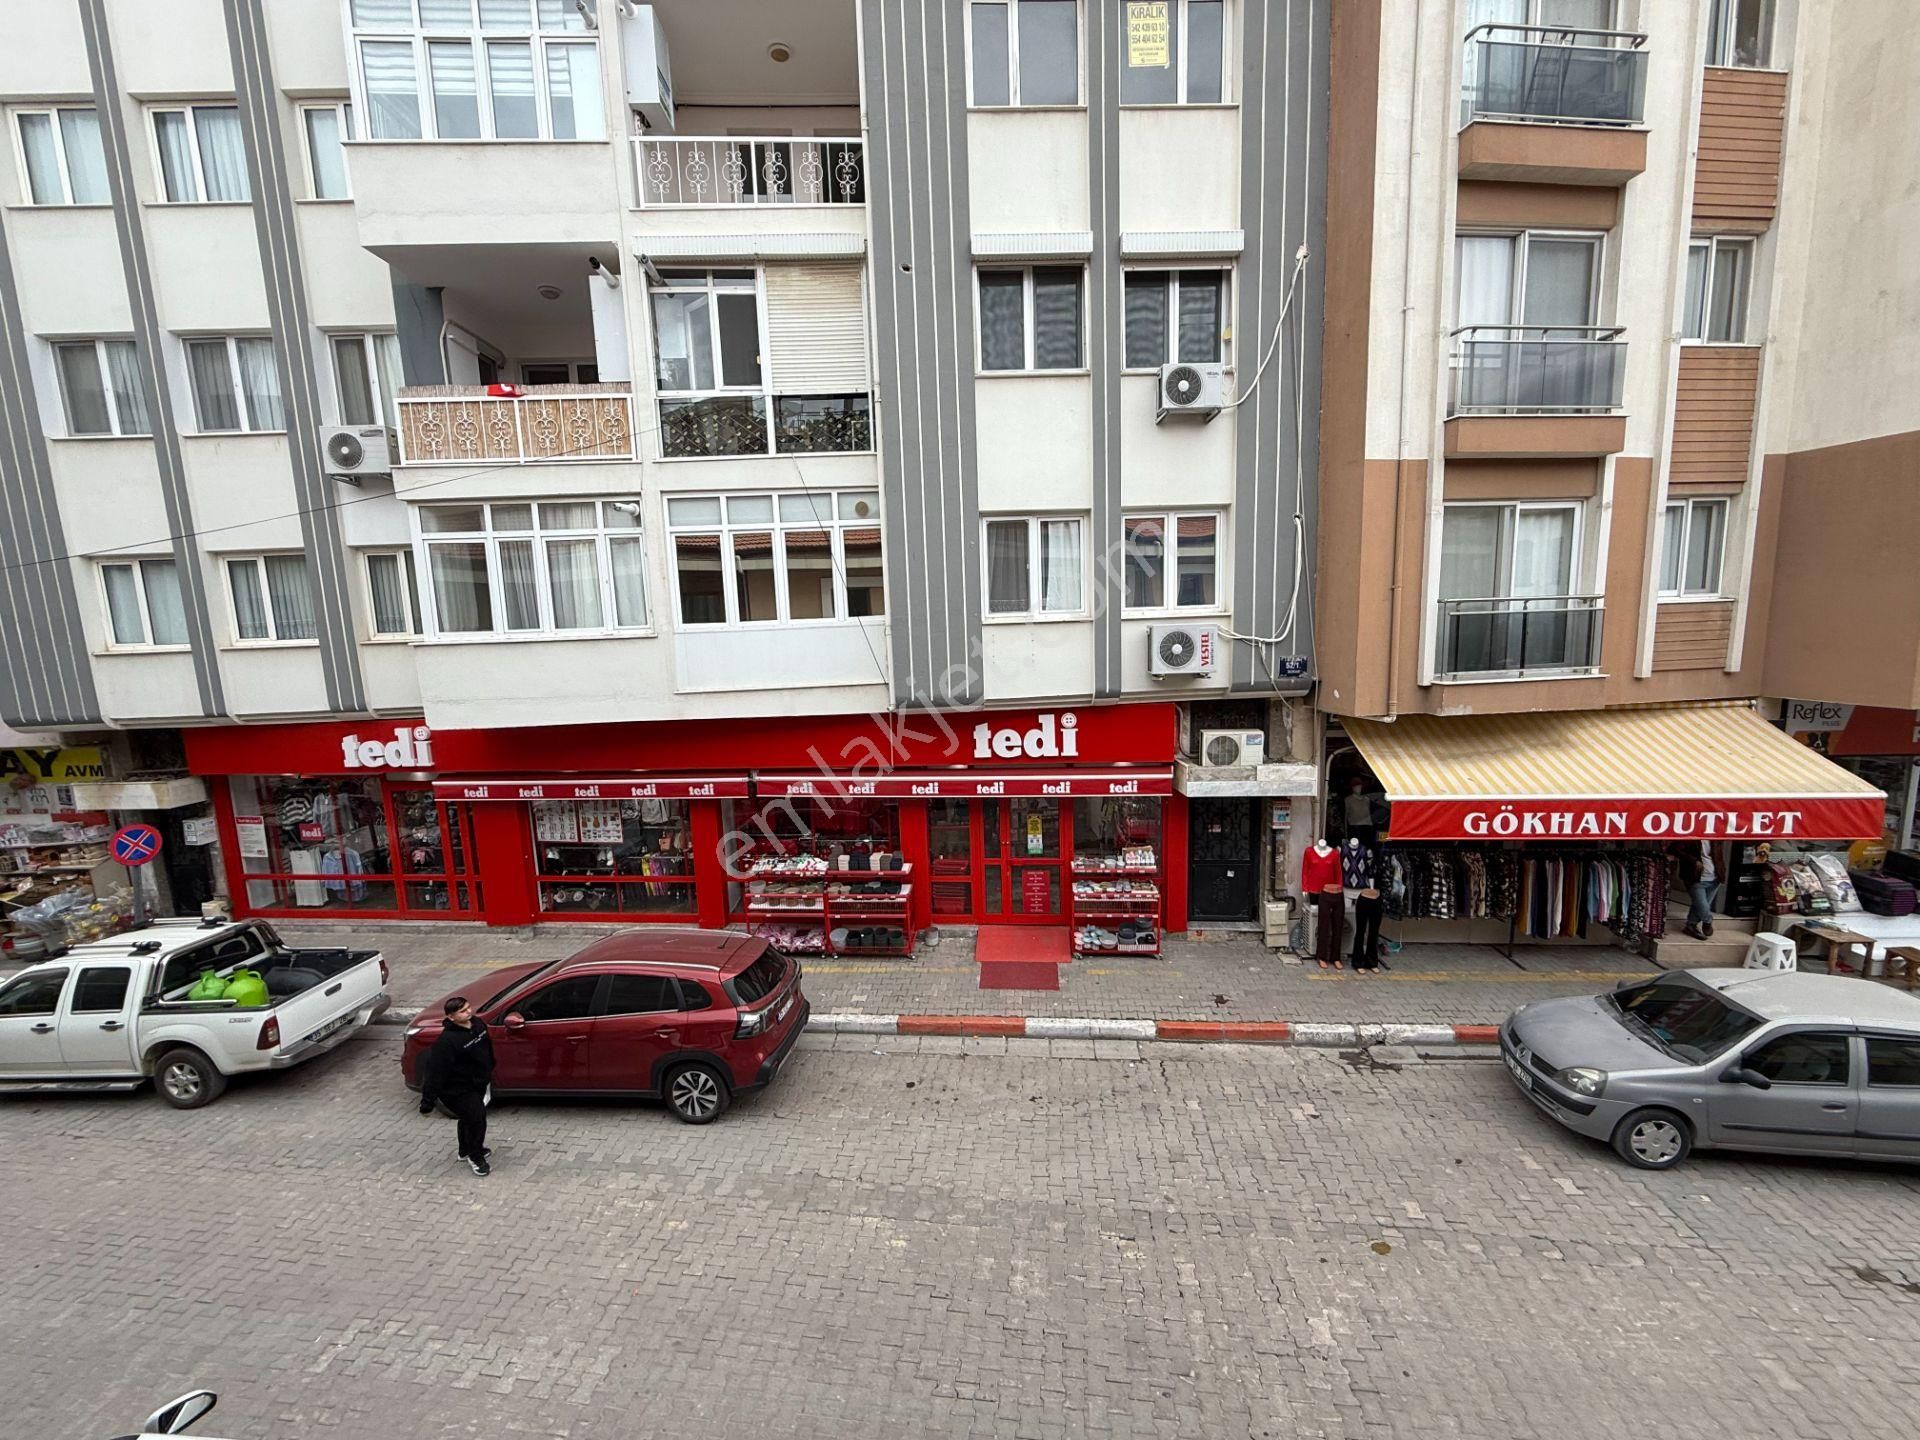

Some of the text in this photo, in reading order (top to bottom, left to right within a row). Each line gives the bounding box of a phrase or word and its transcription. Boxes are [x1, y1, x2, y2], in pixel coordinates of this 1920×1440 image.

[1201, 631, 1209, 667] VESTEL
[1792, 701, 1842, 723] Reflex
[973, 712, 1078, 758] tedi
[341, 726, 435, 768] tedi
[65, 765, 104, 777] AVM
[464, 784, 714, 798] tedi tedi tedi tedi tedi
[787, 780, 1138, 794] tedi tedi tedi tedi tedi tedi
[1463, 805, 1802, 835] GÖKHAN OUTLET
[302, 828, 321, 838] tedi
